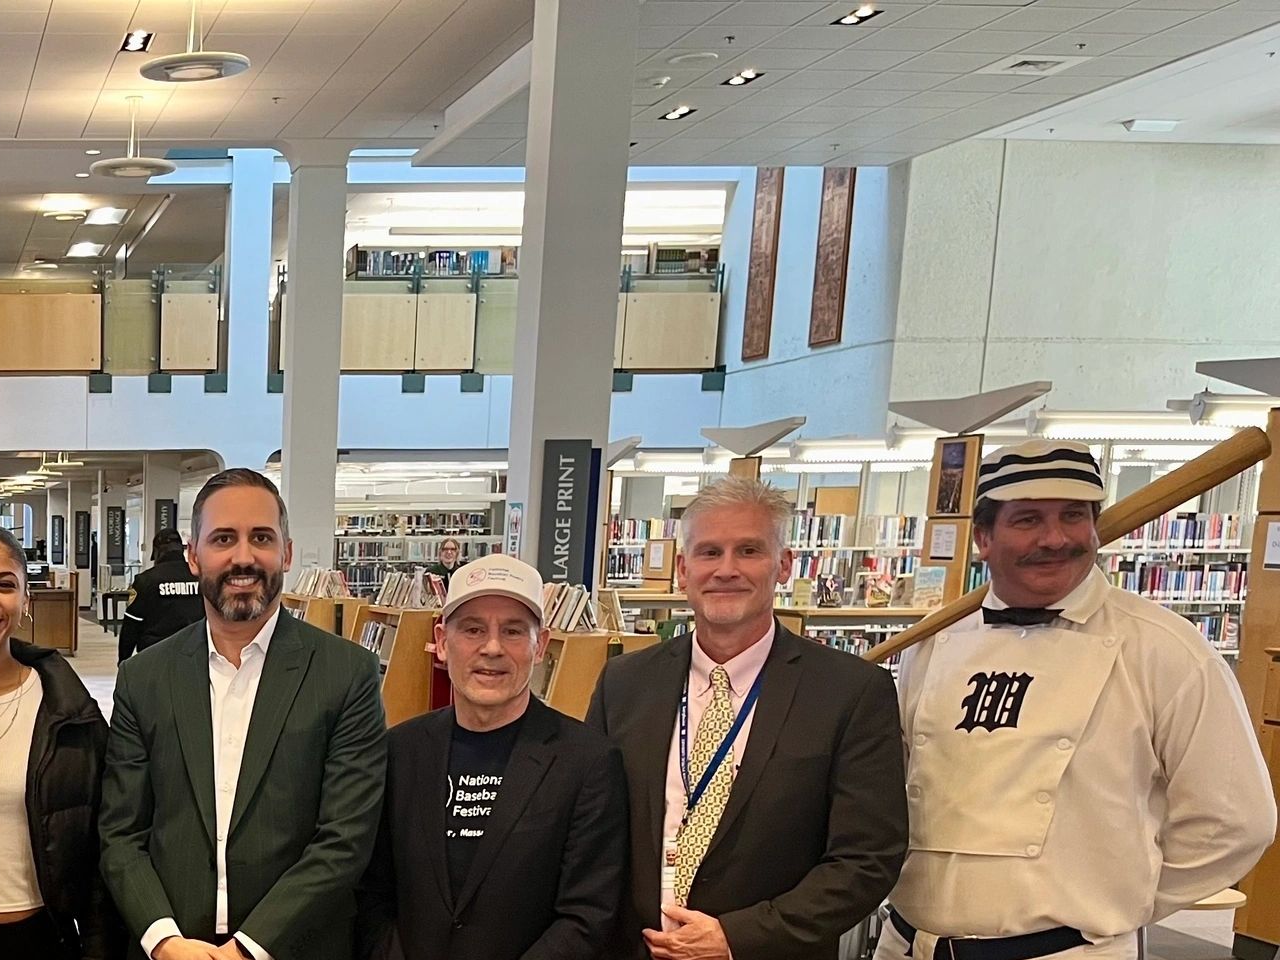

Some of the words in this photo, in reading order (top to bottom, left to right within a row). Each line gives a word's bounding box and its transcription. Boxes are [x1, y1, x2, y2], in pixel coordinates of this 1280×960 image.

[556, 454, 576, 512] PRINT
[160, 505, 168, 530] RAPHY
[552, 517, 572, 579] LARGE
[158, 582, 199, 596] SECURITY
[954, 671, 1034, 734] W
